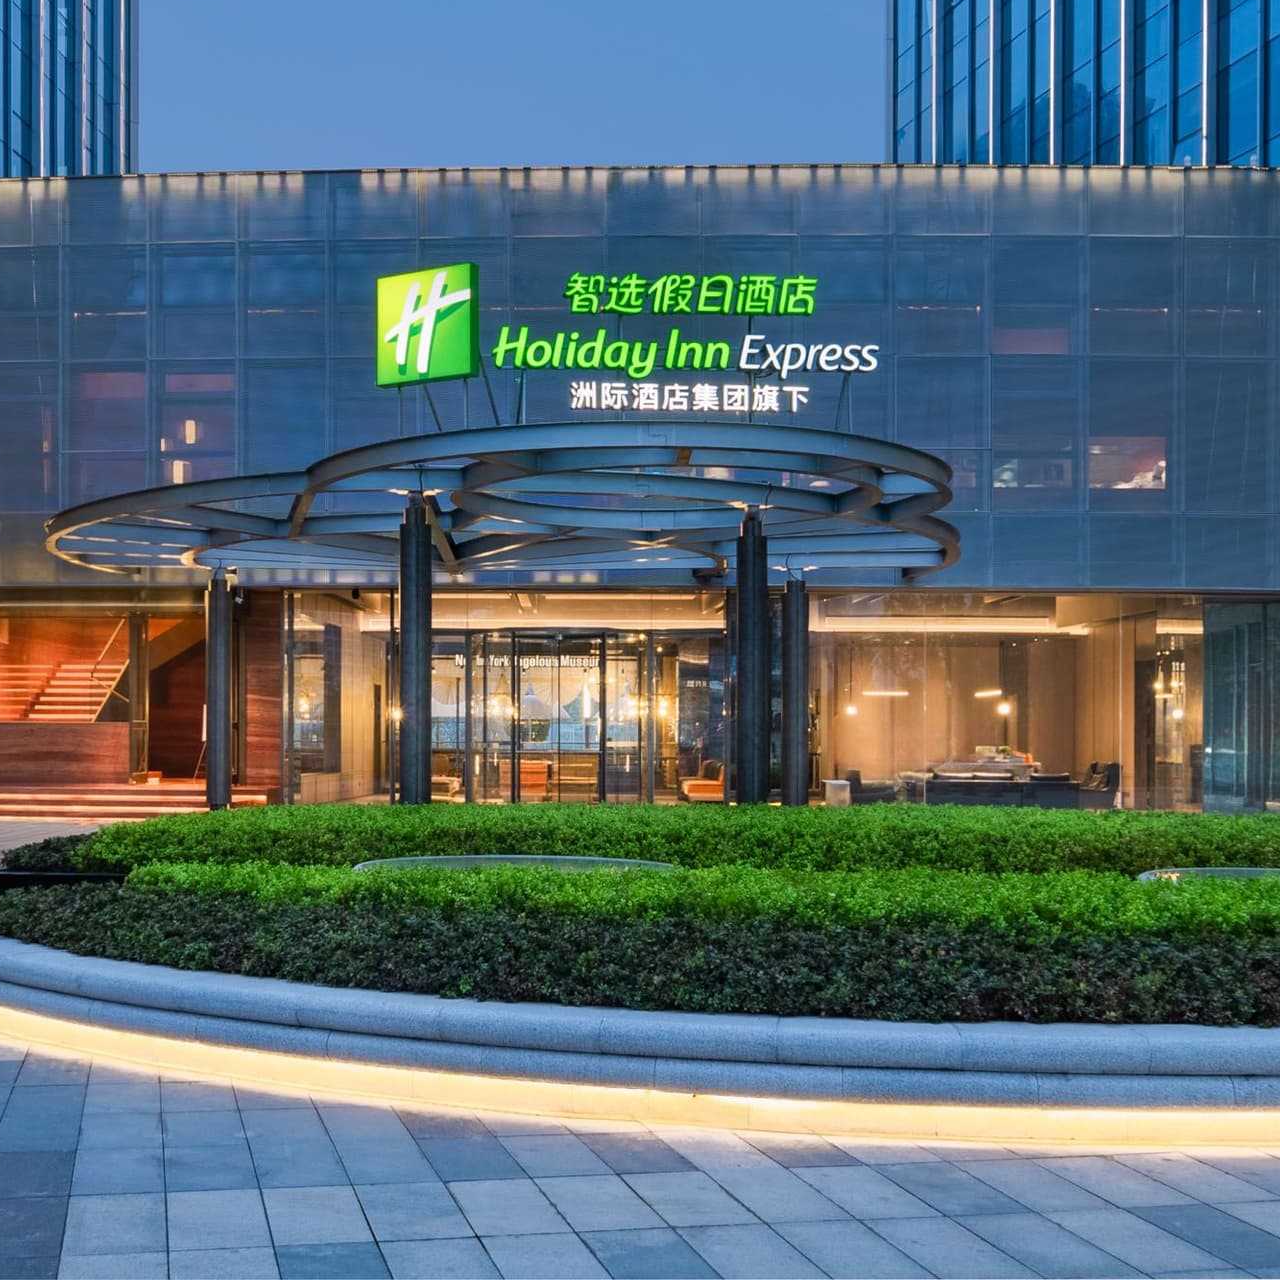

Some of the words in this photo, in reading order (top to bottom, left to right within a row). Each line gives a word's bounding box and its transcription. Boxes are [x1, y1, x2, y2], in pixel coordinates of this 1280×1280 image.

[565, 272, 818, 314] 智选假日酒店
[492, 326, 658, 379] Holiday
[665, 328, 730, 369] Inn
[738, 334, 880, 380] Express
[570, 381, 810, 412] 洲际酒店集团旗下
